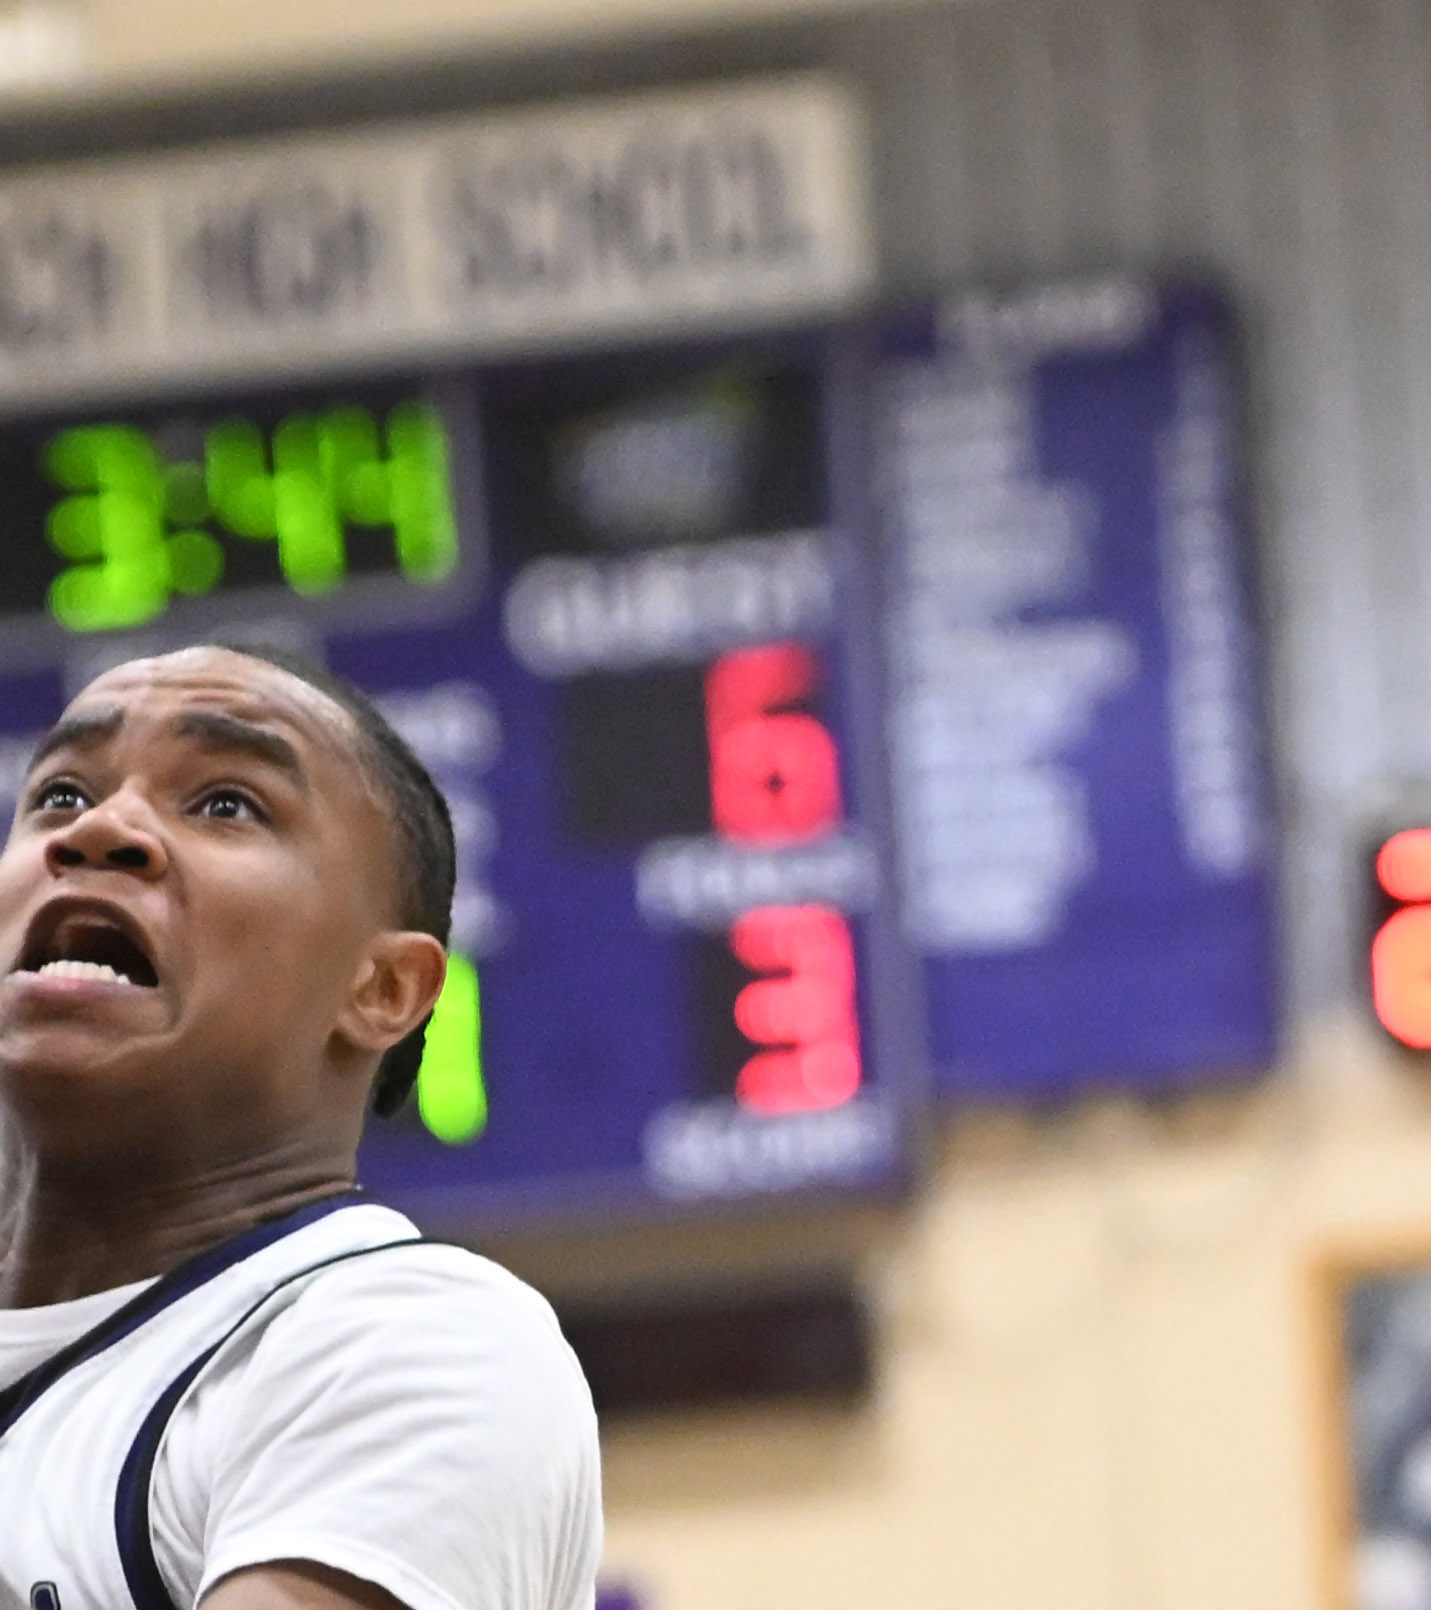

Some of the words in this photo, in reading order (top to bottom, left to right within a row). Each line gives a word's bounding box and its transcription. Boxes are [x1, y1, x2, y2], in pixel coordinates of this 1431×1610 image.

[46, 405, 458, 632] 3:44
[704, 642, 846, 846] 6
[732, 903, 863, 1118] 3
